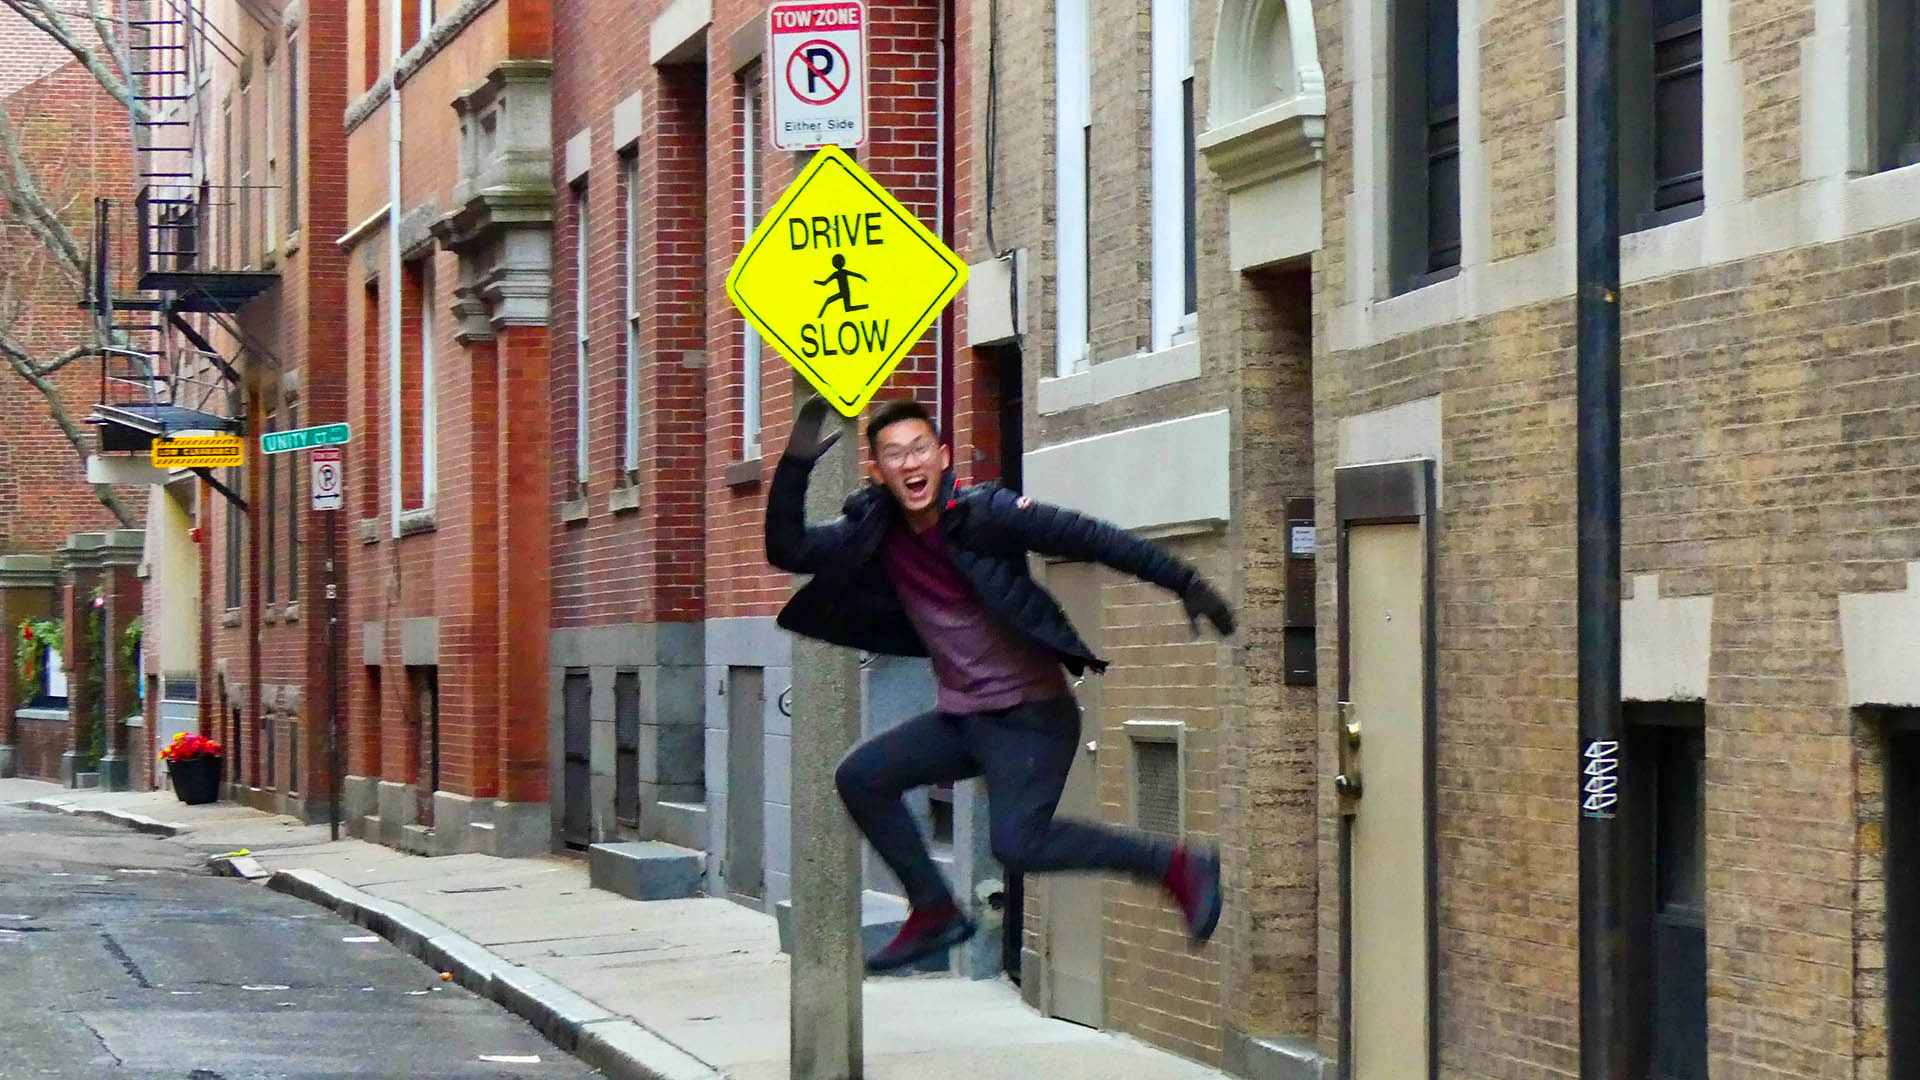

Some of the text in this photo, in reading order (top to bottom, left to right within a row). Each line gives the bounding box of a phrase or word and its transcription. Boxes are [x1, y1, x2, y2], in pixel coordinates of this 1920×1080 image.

[773, 8, 859, 28] TOW ZONE
[806, 48, 834, 93] P
[784, 119, 855, 132] Either Side
[789, 212, 884, 250] DRIVE
[800, 319, 890, 358] SLOW
[266, 431, 308, 451] UNITY
